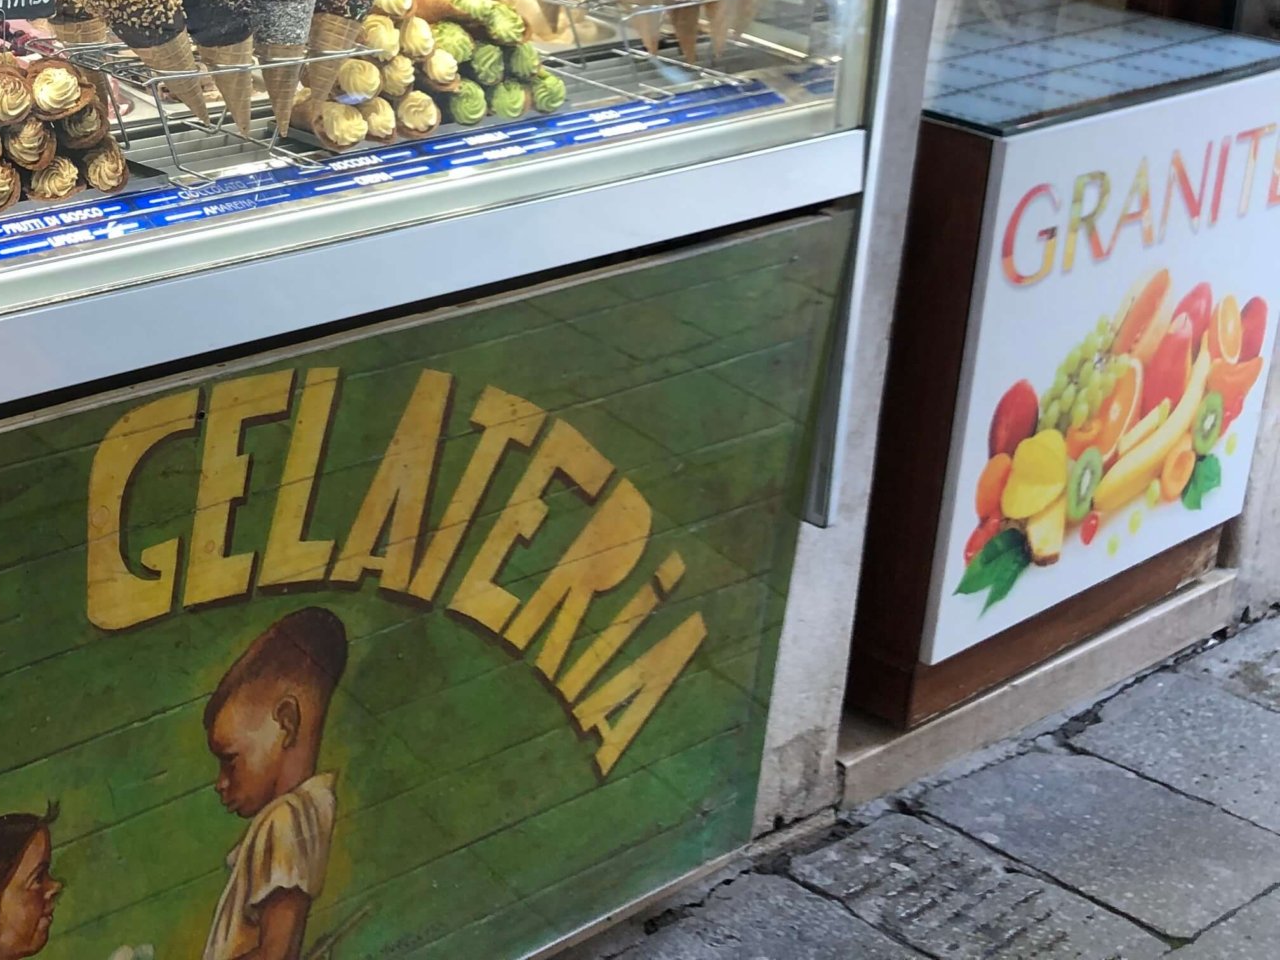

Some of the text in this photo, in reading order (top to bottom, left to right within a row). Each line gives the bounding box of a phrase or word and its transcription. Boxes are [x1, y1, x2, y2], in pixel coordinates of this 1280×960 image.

[1, 206, 105, 235] FRUTTI DI BOSCO
[1000, 122, 1280, 288] GRANIT
